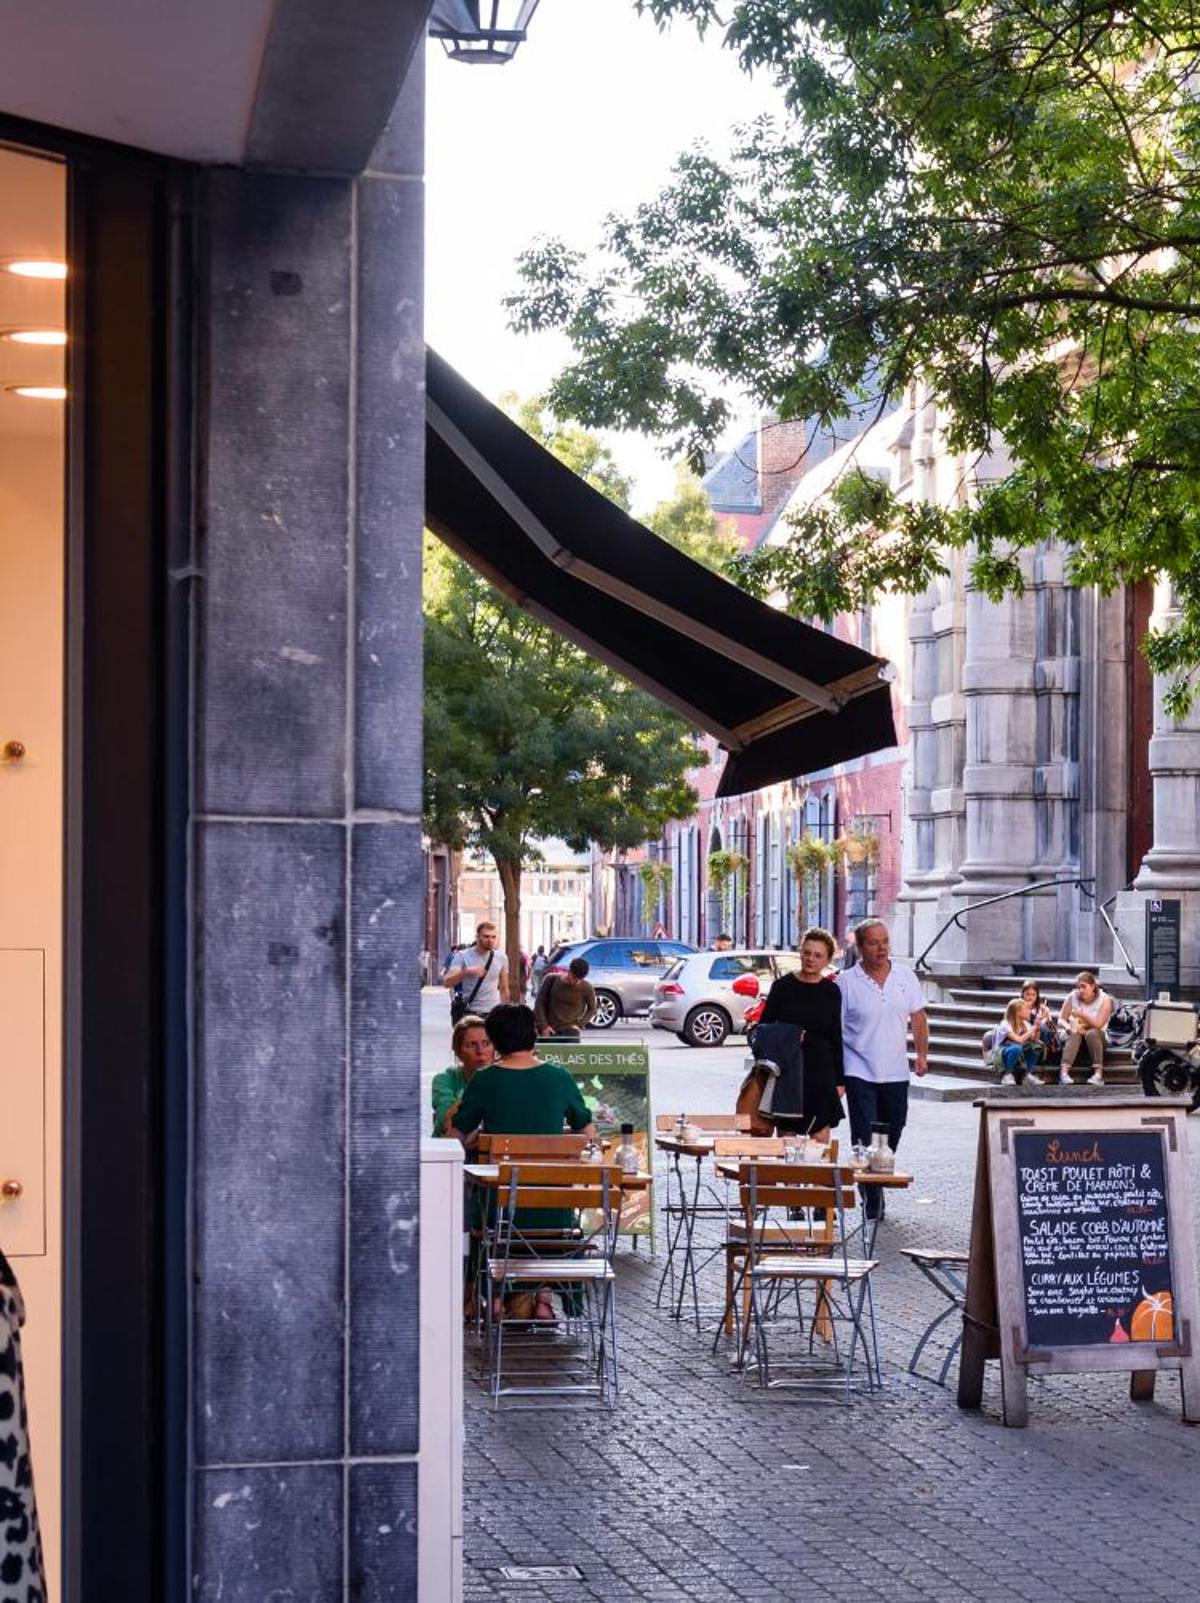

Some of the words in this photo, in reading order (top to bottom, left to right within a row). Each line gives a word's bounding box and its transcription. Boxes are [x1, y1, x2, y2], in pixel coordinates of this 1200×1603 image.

[545, 1053, 586, 1066] PALAIS
[590, 1053, 613, 1066] DES
[617, 1051, 646, 1066] THÉS
[1046, 1139, 1104, 1163] Lunch
[1020, 1167, 1057, 1181] TOAST
[1062, 1166, 1104, 1181] POULET
[1140, 1163, 1152, 1179] &
[1066, 1180, 1081, 1192] DE
[1086, 1178, 1136, 1192] MARRONS
[1029, 1219, 1077, 1236] SALADE
[1081, 1220, 1110, 1235] COBB
[1111, 1217, 1166, 1234] D'AUTOMNE
[1031, 1272, 1062, 1285] CURRY
[1062, 1273, 1084, 1285] AUX
[1086, 1265, 1140, 1286] LÉGUMES
